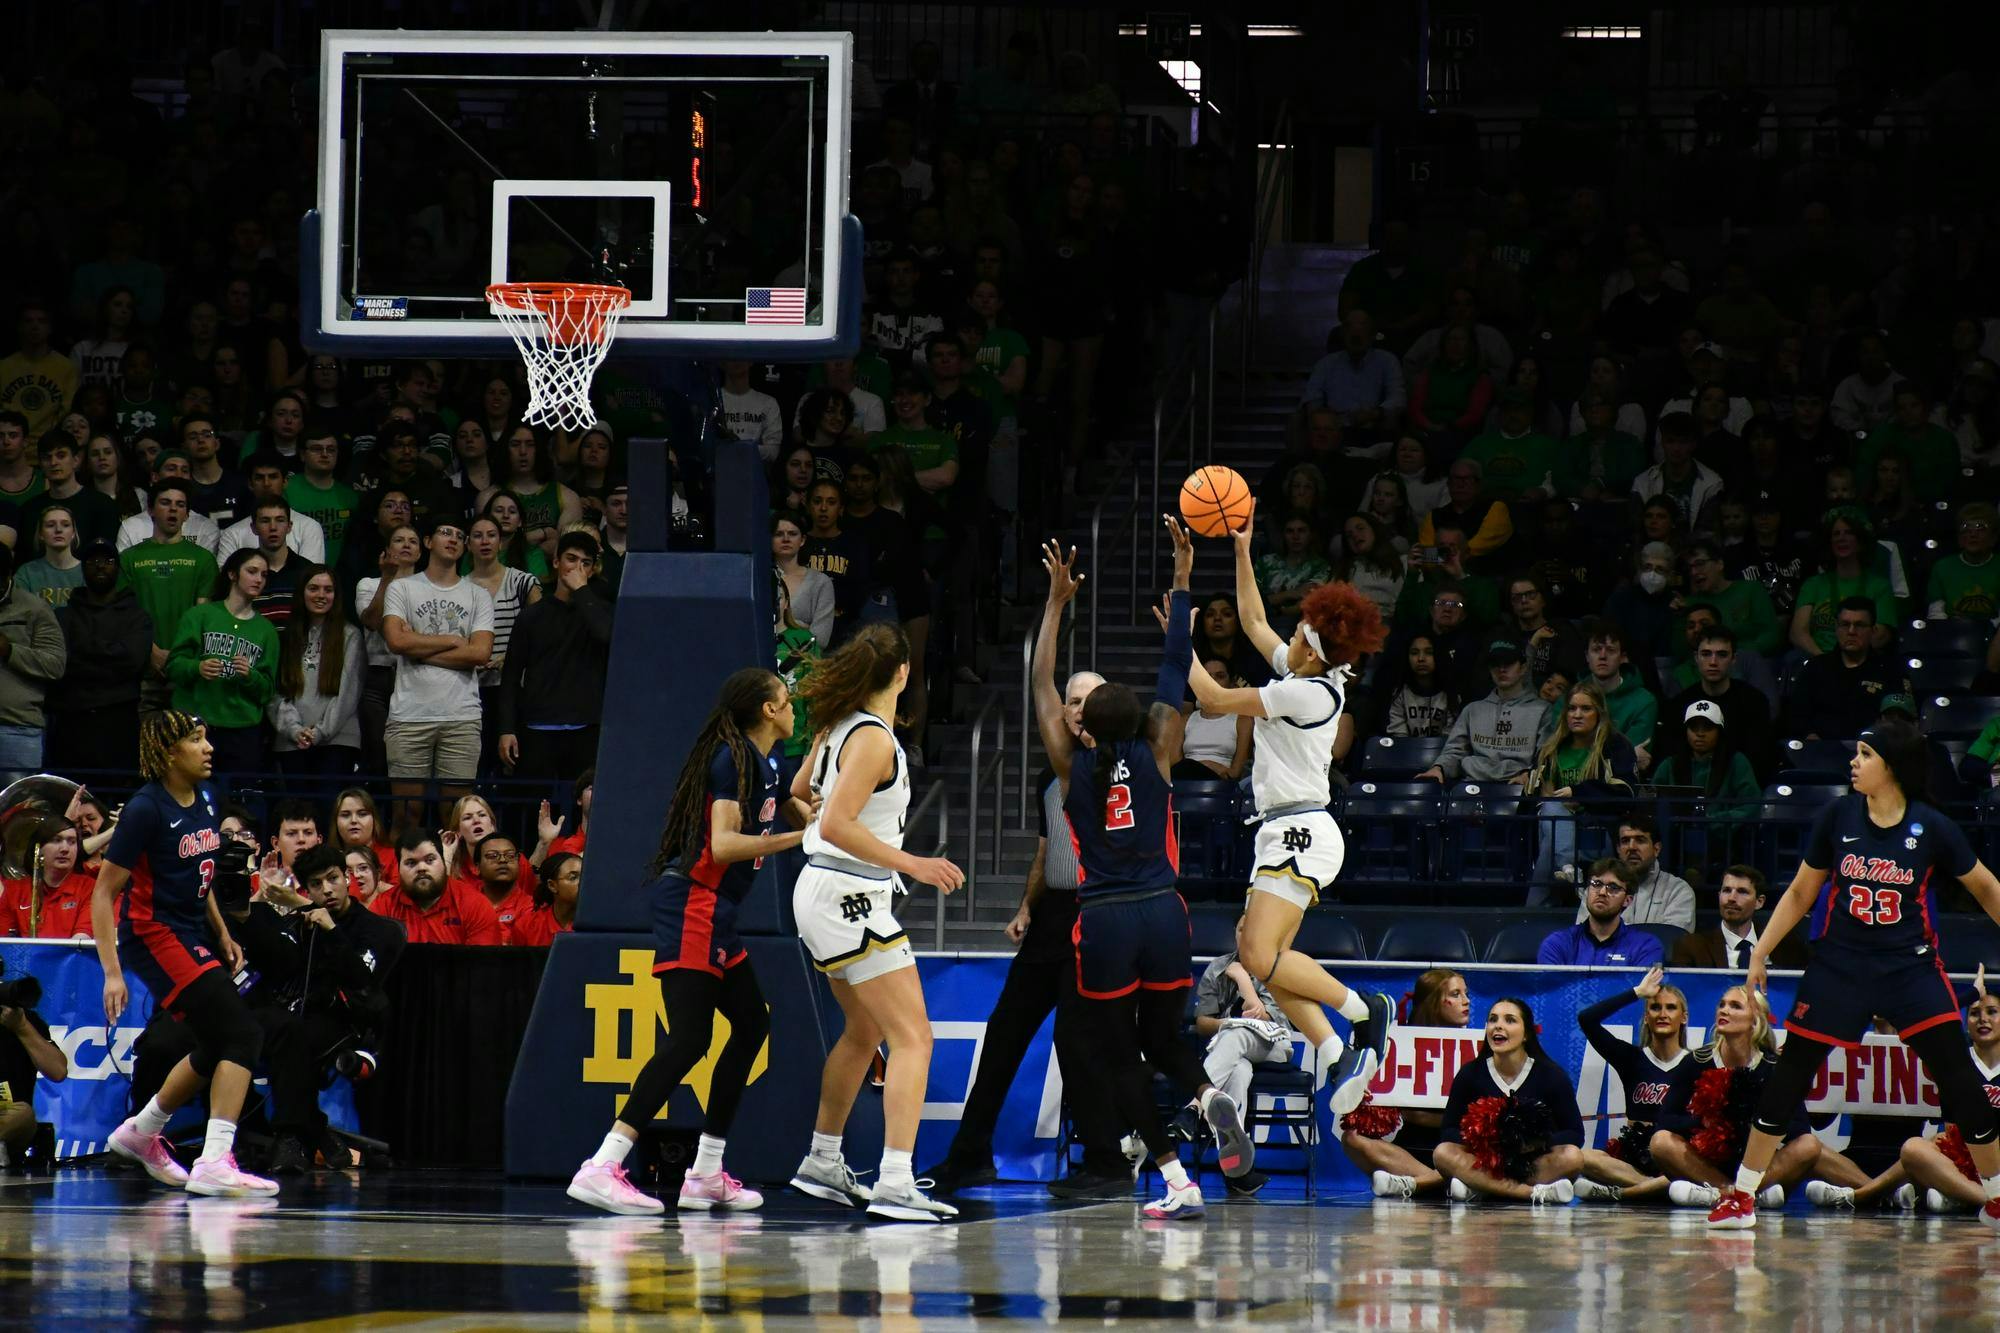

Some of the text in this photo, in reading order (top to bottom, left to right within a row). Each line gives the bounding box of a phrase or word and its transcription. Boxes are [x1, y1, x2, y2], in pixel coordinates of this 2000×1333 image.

[1443, 28, 1475, 48] 115
[364, 298, 393, 309] MARCH
[366, 308, 406, 317] MADNESS
[169, 558, 197, 567] VICTORY
[415, 598, 468, 620] HERE COME
[1473, 734, 1530, 747] NOTRE DAME
[1105, 783, 1136, 831] 2
[178, 832, 201, 859] Ole
[197, 858, 215, 898] 3
[1841, 854, 1914, 885] Ole Miss
[1849, 884, 1902, 925] 23
[1633, 1082, 1658, 1105] Ole
